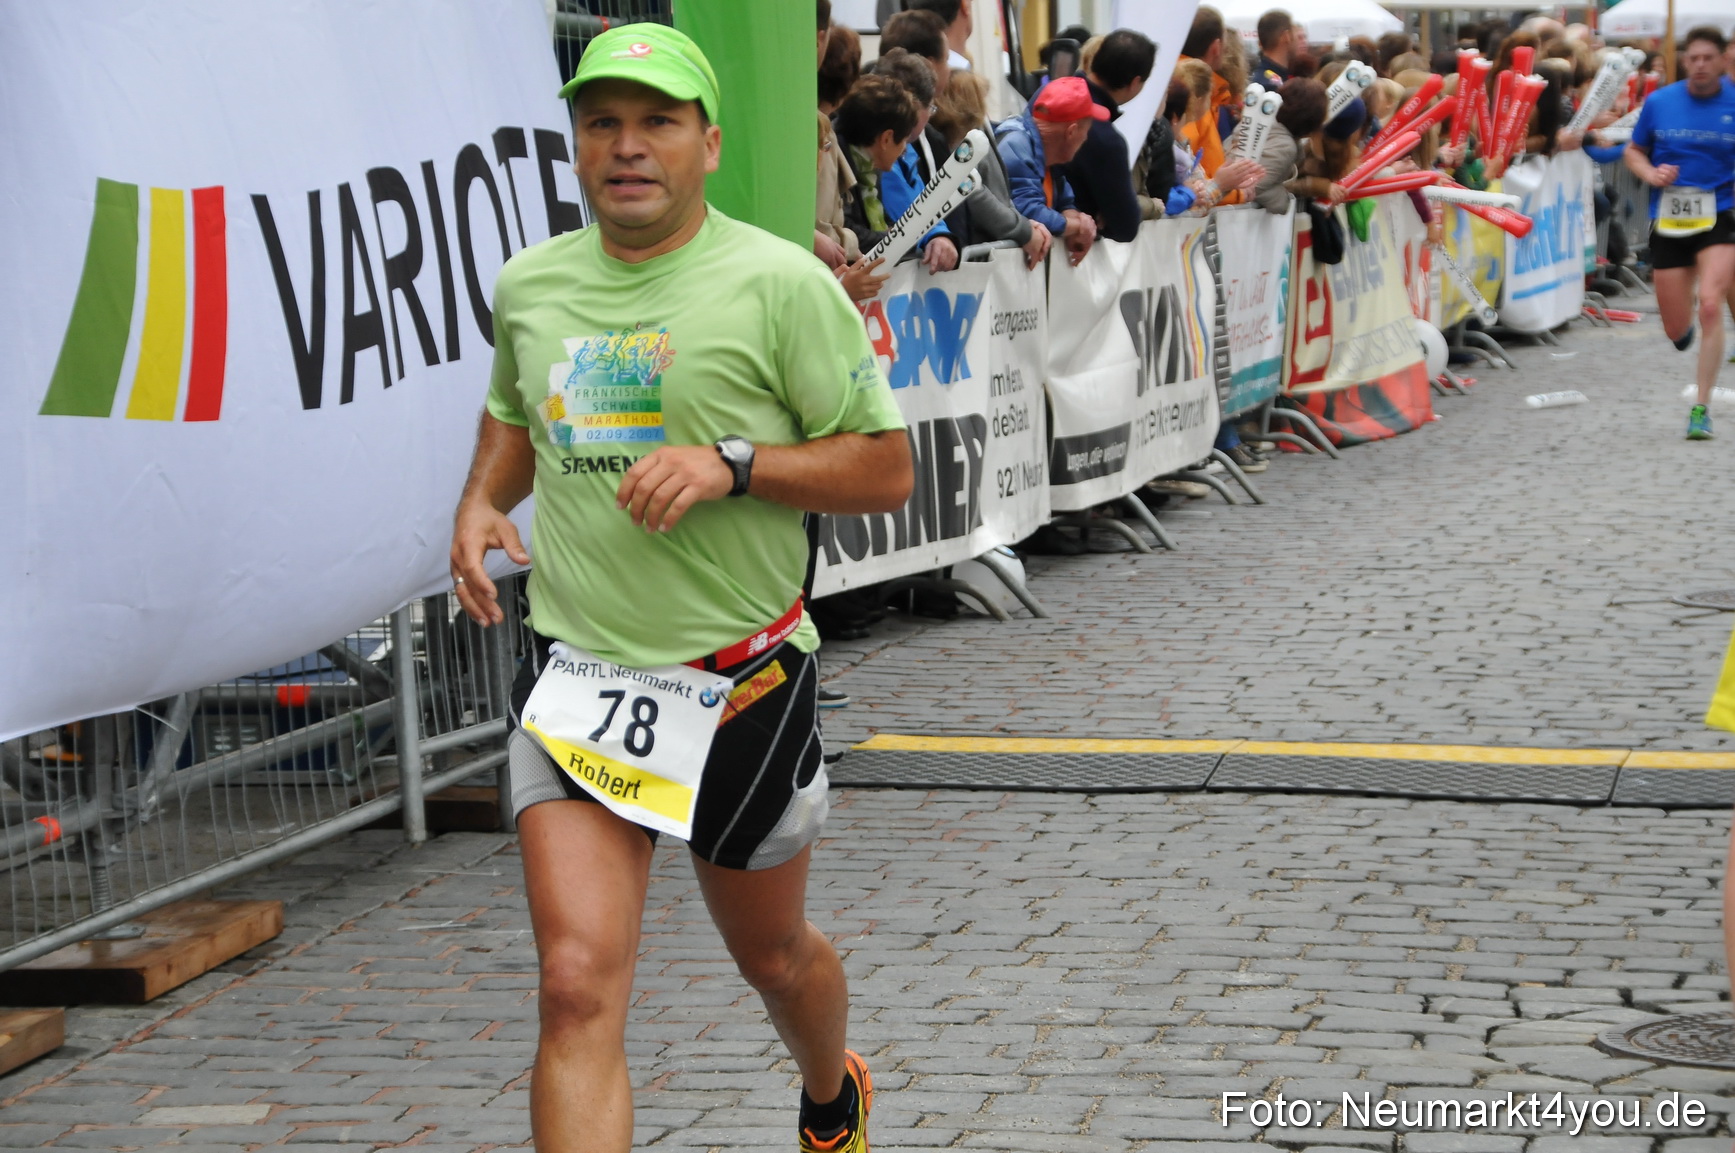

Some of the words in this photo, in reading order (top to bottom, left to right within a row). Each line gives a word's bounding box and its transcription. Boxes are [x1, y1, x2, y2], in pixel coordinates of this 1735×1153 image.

[1671, 198, 1703, 216] 341
[250, 126, 592, 410] VARIOTE
[575, 386, 658, 399] FRÄNKISCHE
[583, 414, 660, 426] MARATHON
[586, 428, 660, 441] 02.09.2007
[552, 659, 606, 678] PARTL
[610, 663, 693, 699] Neumarkt
[587, 689, 659, 758] 78
[568, 752, 642, 800] Robert
